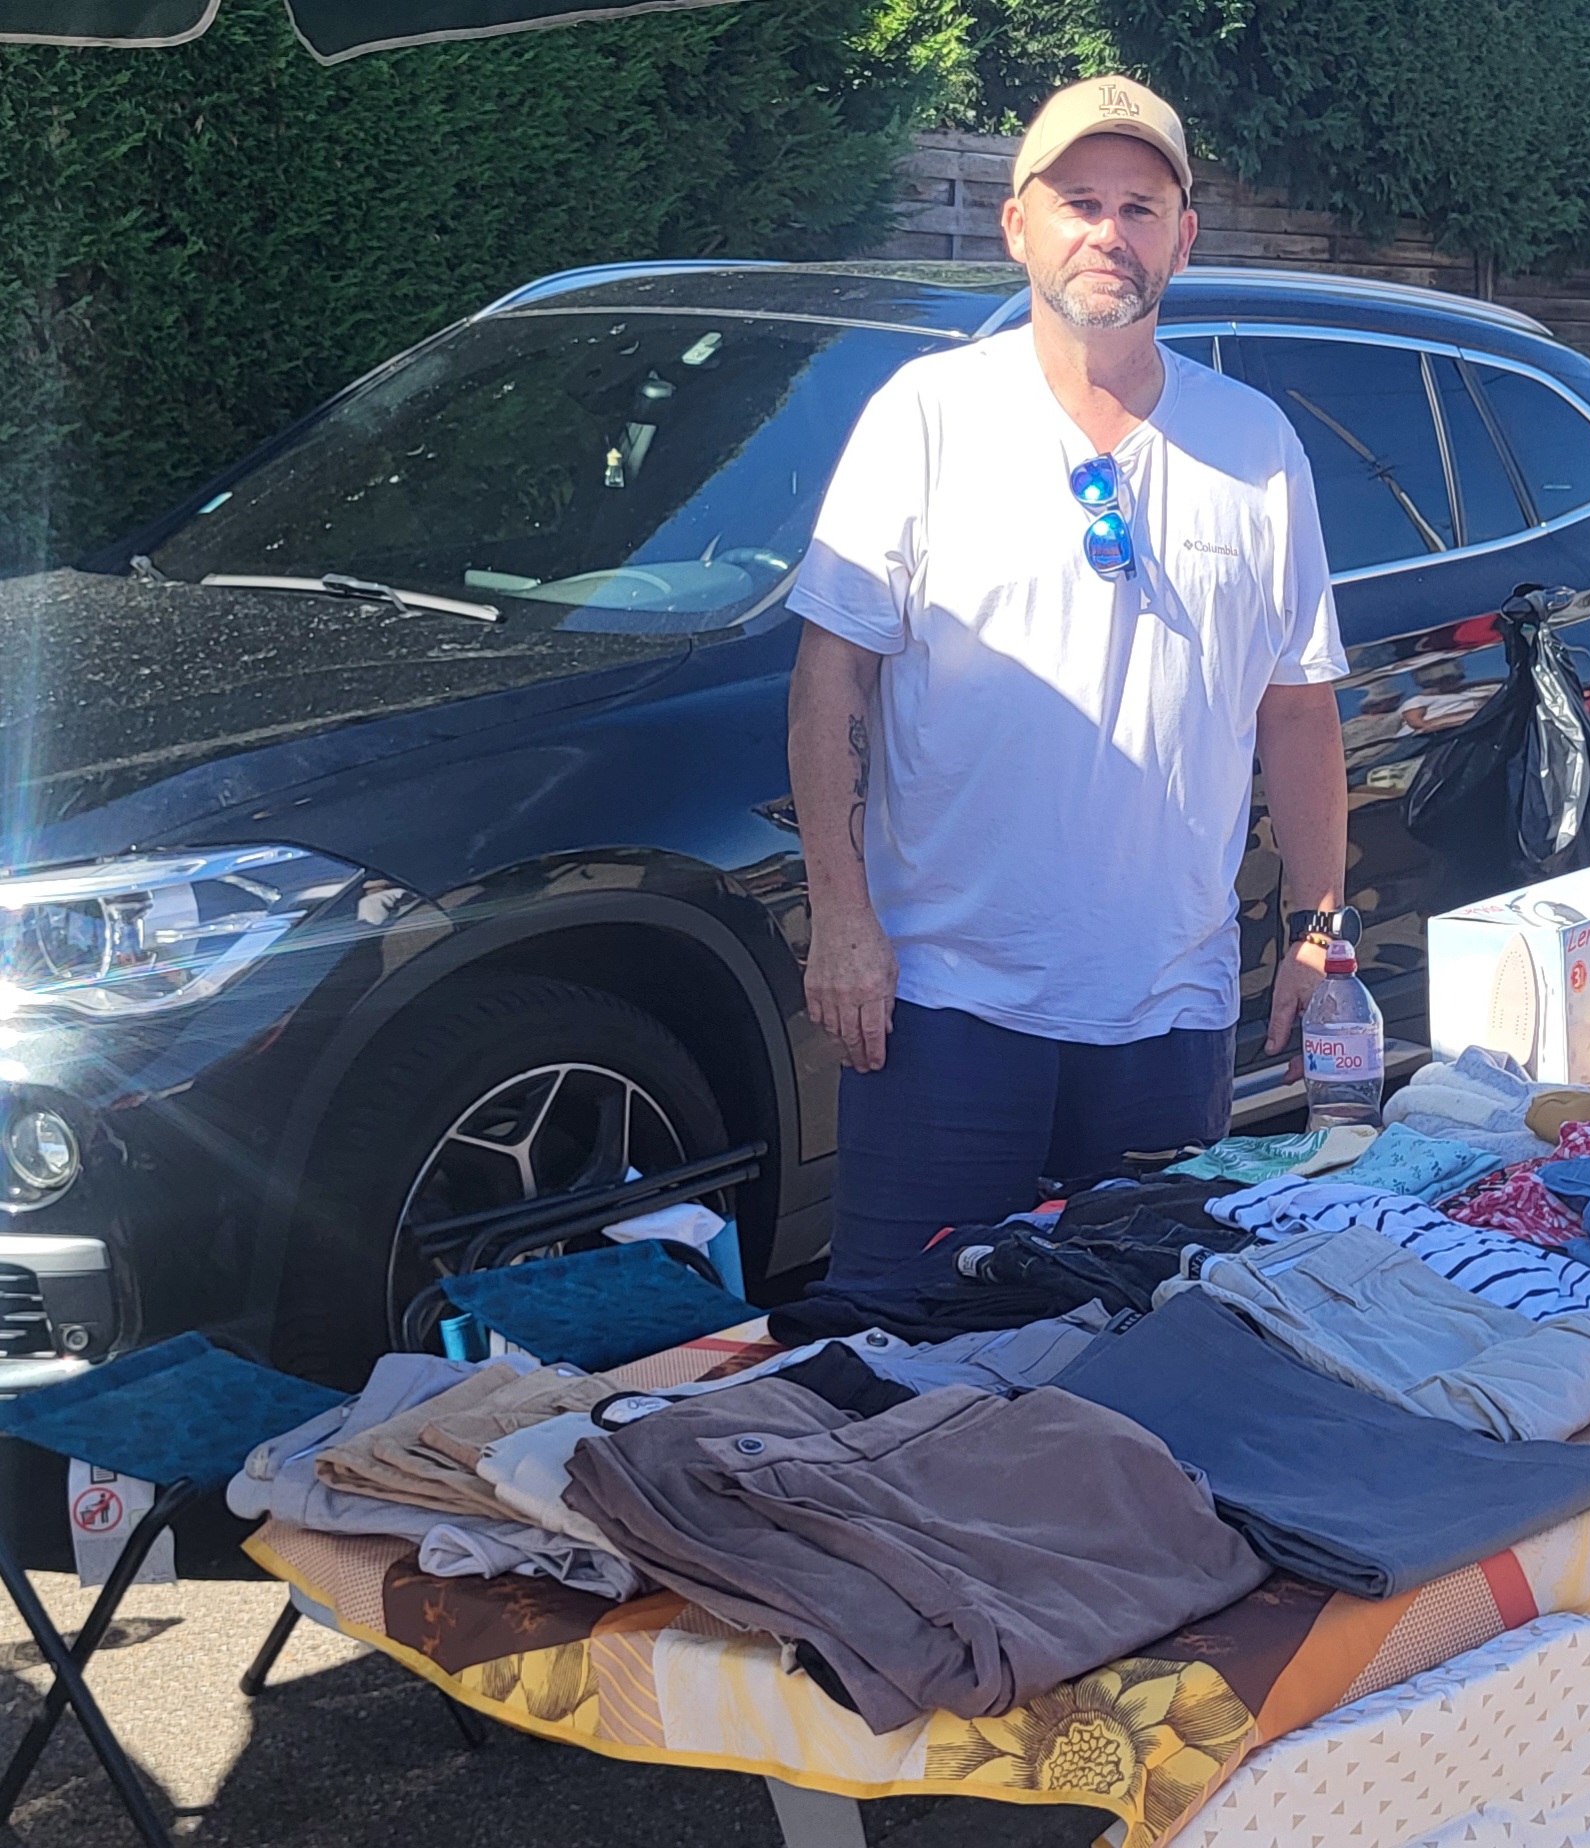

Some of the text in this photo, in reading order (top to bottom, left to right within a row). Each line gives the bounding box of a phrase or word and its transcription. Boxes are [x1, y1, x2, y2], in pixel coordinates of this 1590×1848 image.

[1099, 84, 1140, 117] LA
[1194, 540, 1239, 557] Columbia
[1305, 1039, 1345, 1056] evian
[1335, 1055, 1362, 1069] 200
